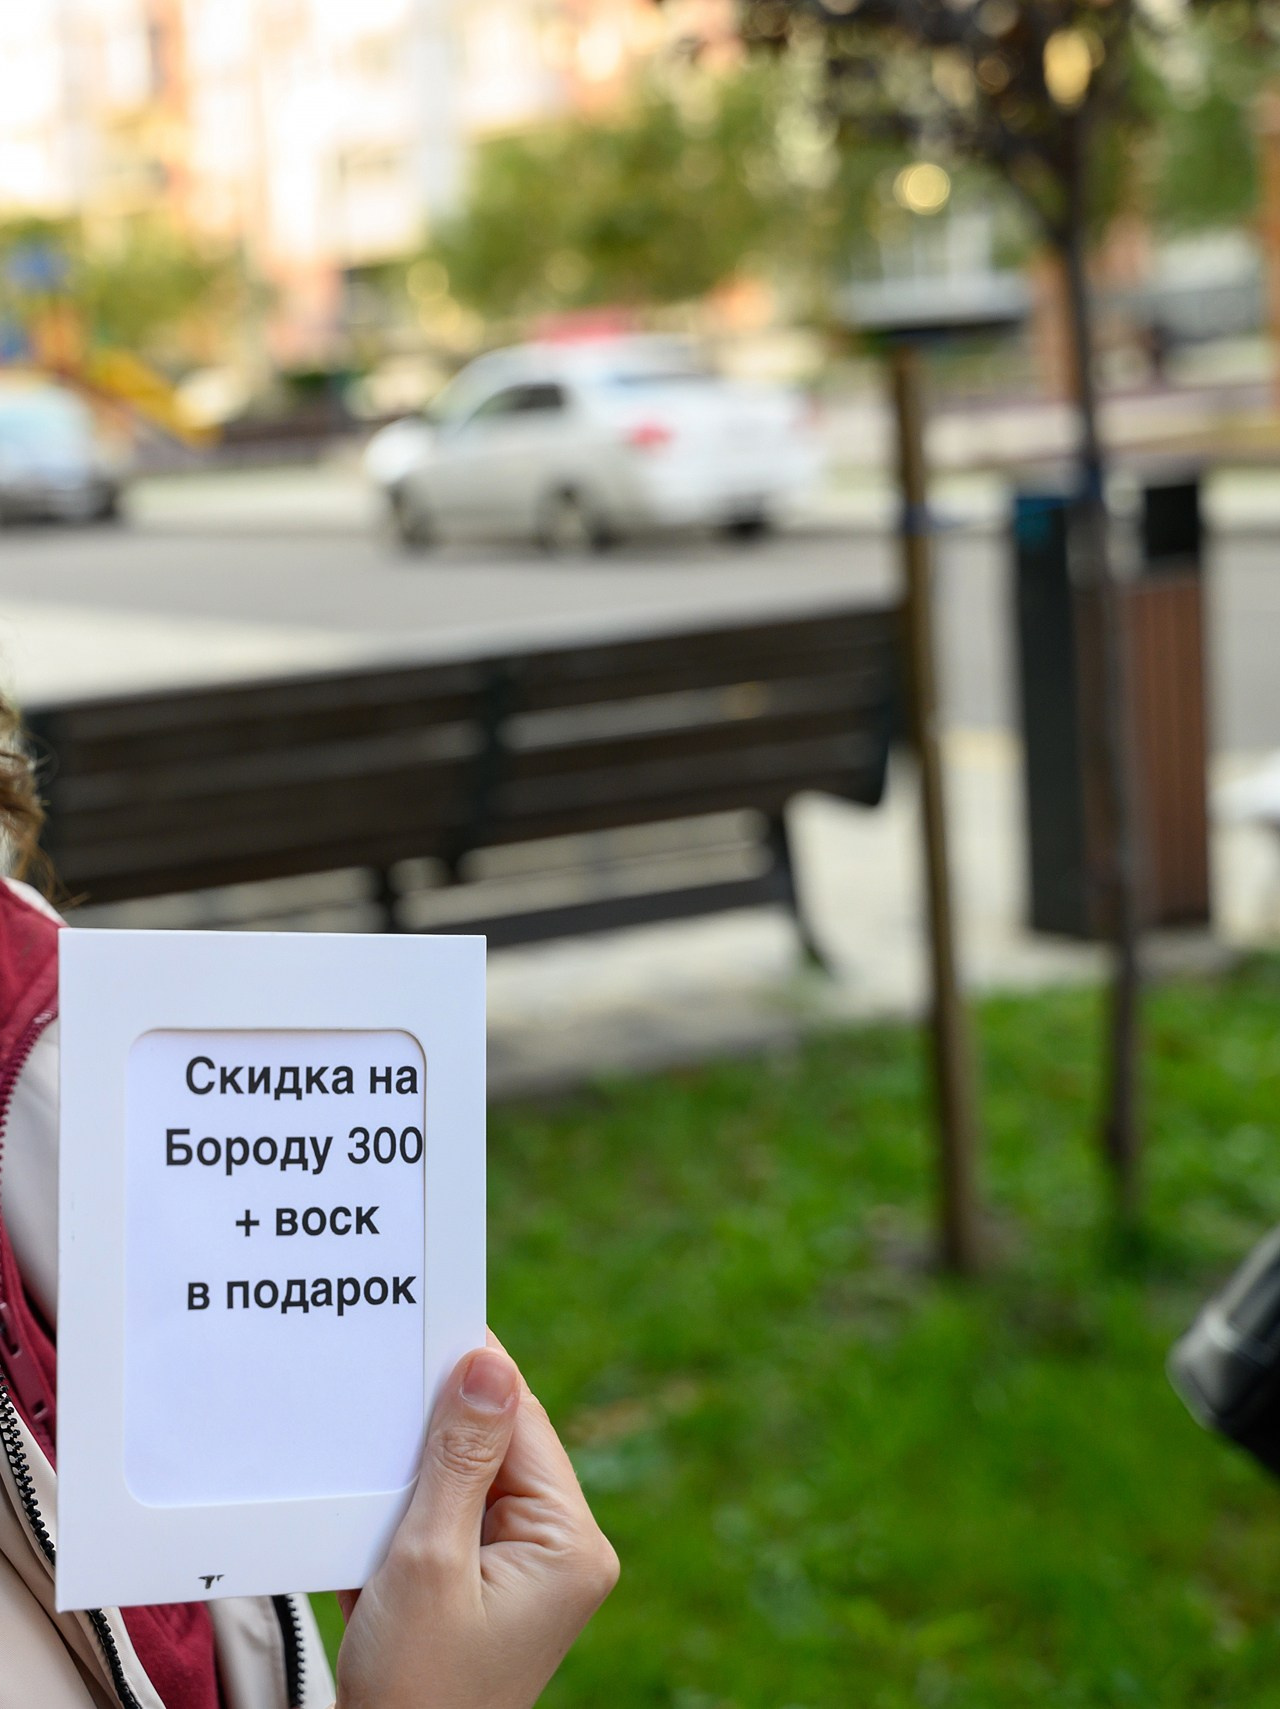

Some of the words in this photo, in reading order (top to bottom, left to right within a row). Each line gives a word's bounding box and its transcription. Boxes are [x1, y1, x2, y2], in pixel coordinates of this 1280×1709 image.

[185, 1055, 355, 1101] Скидка
[369, 1065, 419, 1095] на
[166, 1128, 334, 1176] Бороду
[347, 1126, 424, 1165] 300
[275, 1205, 380, 1237] воск
[187, 1282, 210, 1311] в
[226, 1275, 417, 1317] подарок
